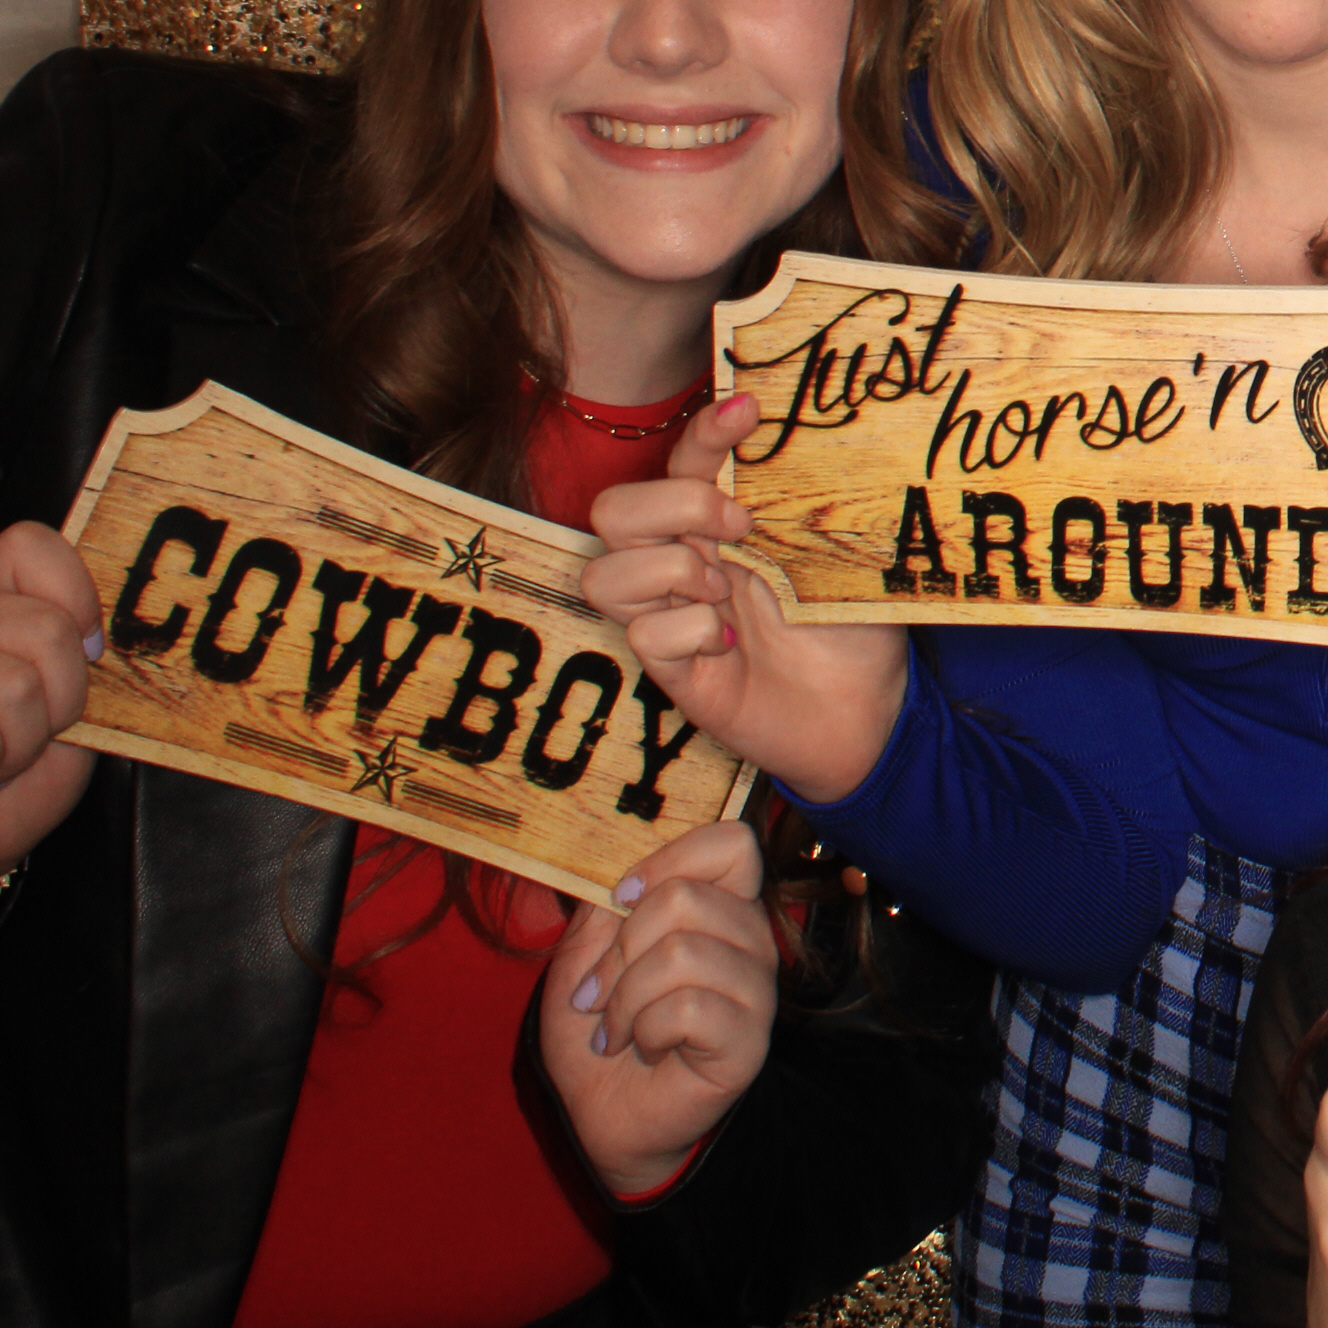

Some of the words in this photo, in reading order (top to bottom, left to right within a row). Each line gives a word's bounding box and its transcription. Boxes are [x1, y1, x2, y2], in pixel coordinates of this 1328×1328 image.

[723, 283, 964, 464] Just
[925, 352, 1280, 480] horse'n
[110, 505, 698, 823] COWBOY
